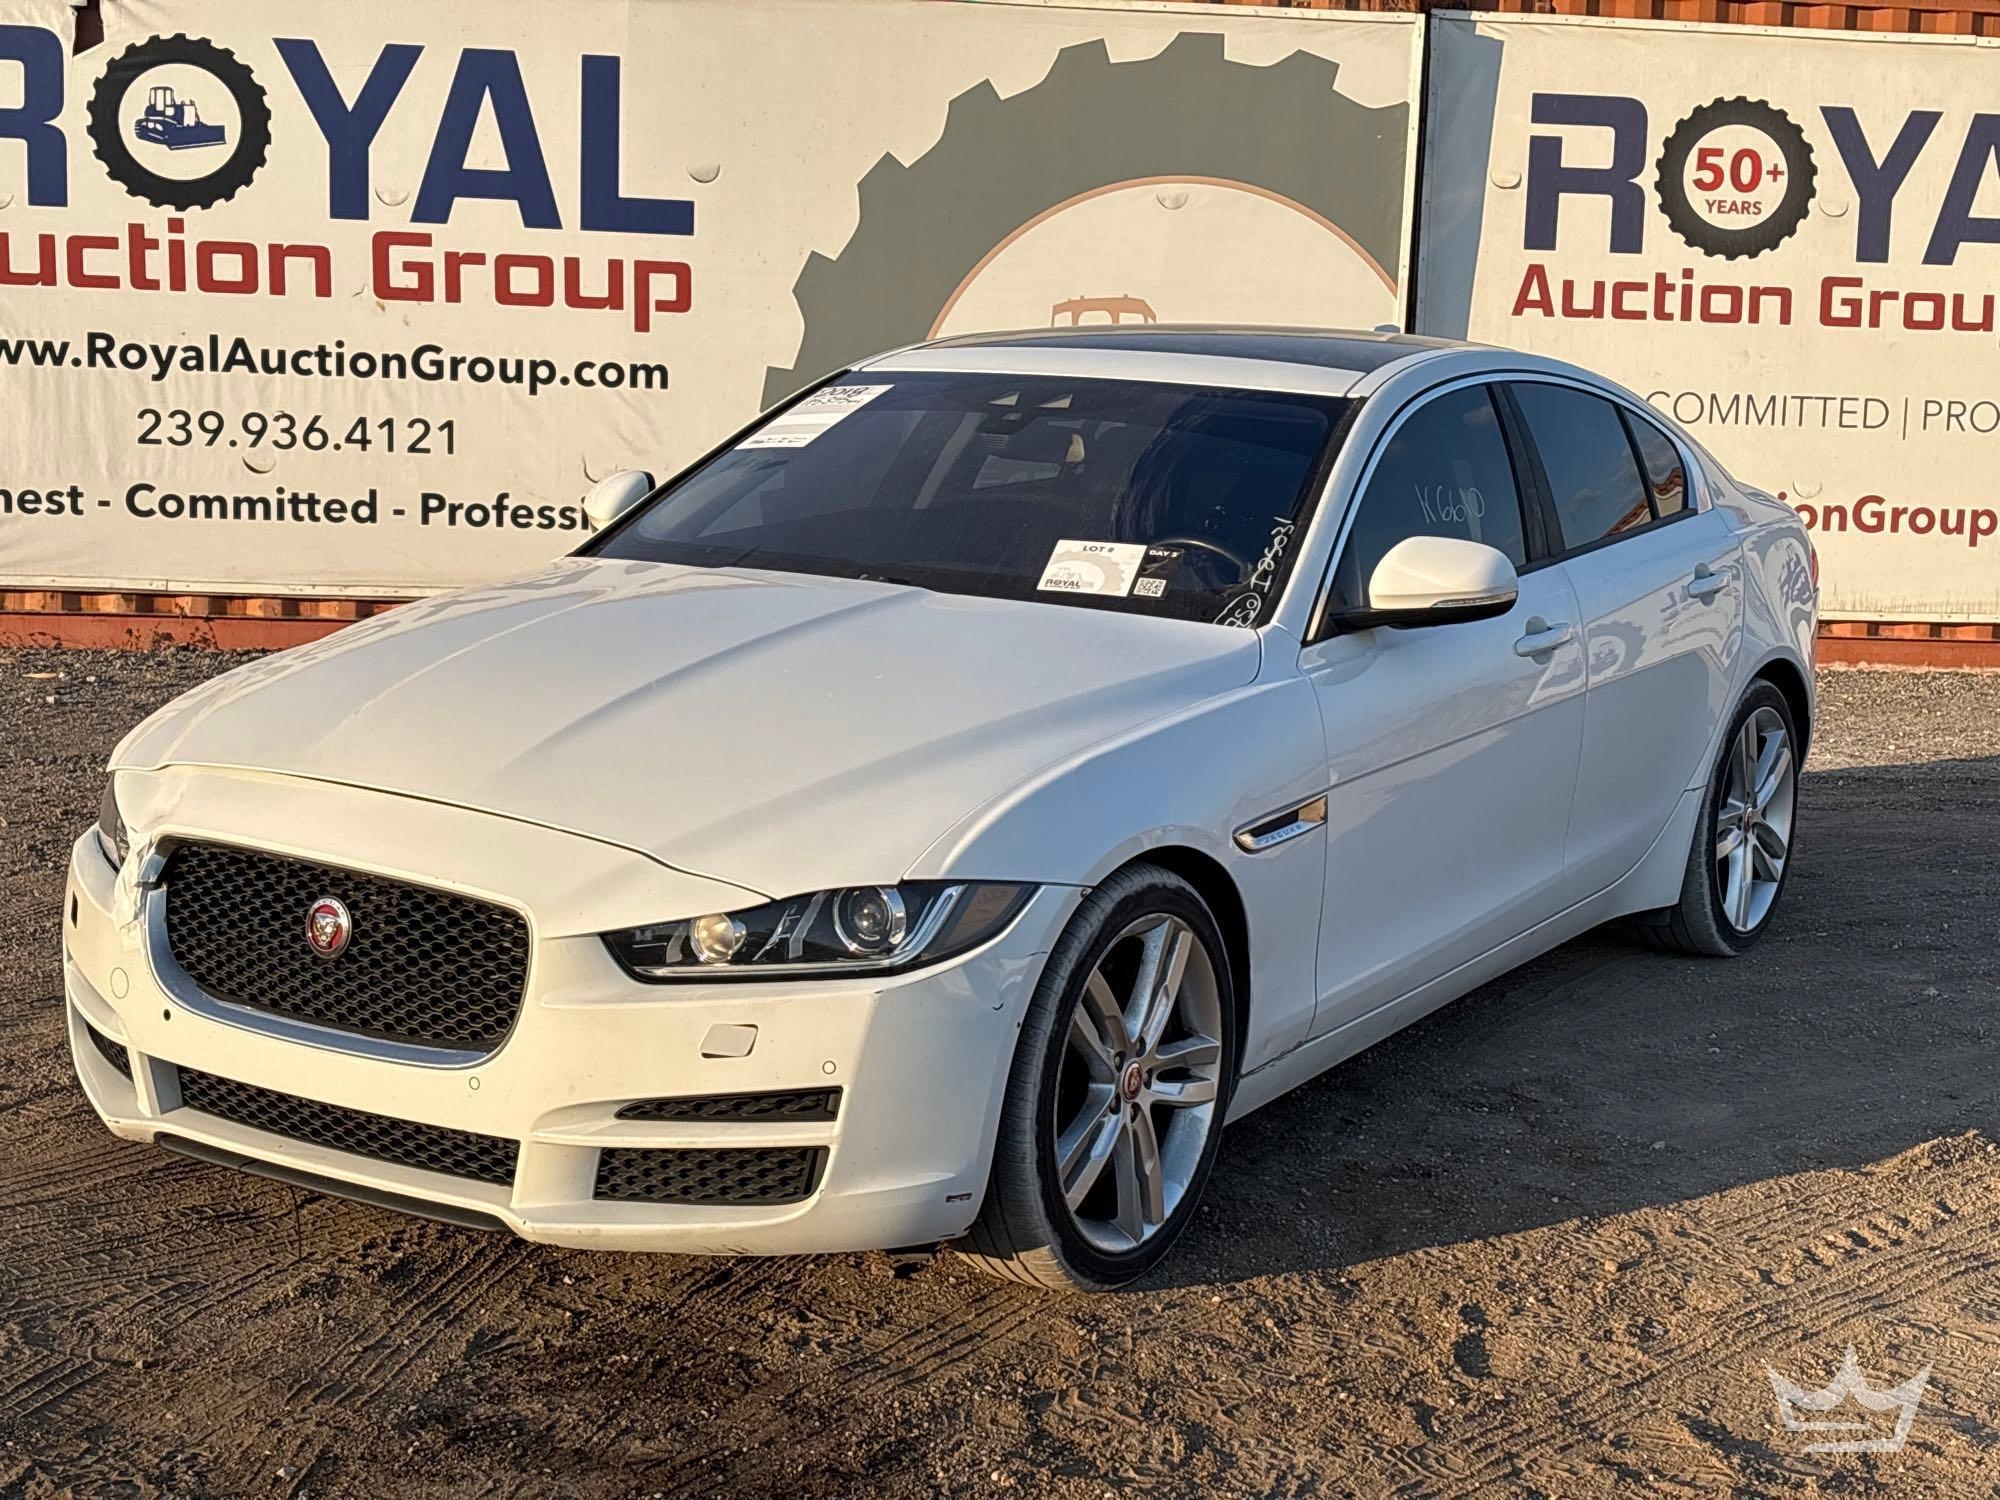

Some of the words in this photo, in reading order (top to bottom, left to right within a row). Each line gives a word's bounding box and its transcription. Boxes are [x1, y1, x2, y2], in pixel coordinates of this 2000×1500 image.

[1692, 147, 1785, 193] 50+
[1705, 199, 1762, 215] YEARS
[0, 217, 332, 299] uction
[372, 231, 692, 332] Group
[1511, 264, 1792, 326] Auction
[1818, 276, 1996, 332] Grou
[137, 408, 455, 454] 239.936.4121
[1922, 399, 2000, 433] PRO
[125, 482, 378, 524] Committed
[1778, 491, 1999, 547] onGroup
[1083, 545, 1105, 553] LOT
